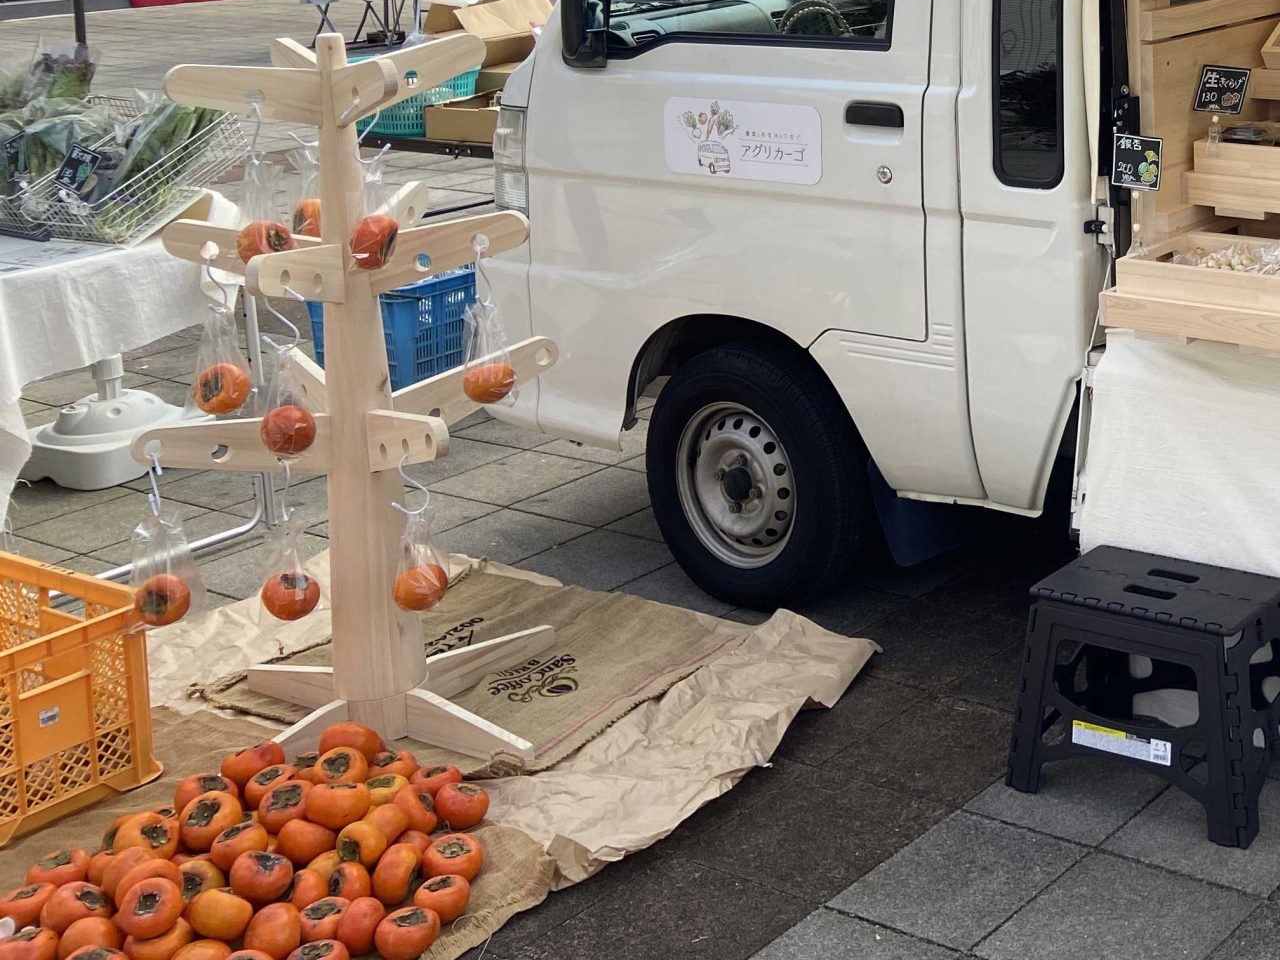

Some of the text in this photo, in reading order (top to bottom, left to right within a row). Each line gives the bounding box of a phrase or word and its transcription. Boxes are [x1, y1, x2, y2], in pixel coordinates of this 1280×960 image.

[1204, 71, 1247, 89] 生きくらげ
[1202, 92, 1217, 102] 130
[740, 143, 806, 162] アグリカーゴ
[1117, 137, 1142, 151] 銀杏
[487, 653, 577, 697] SanCoffee
